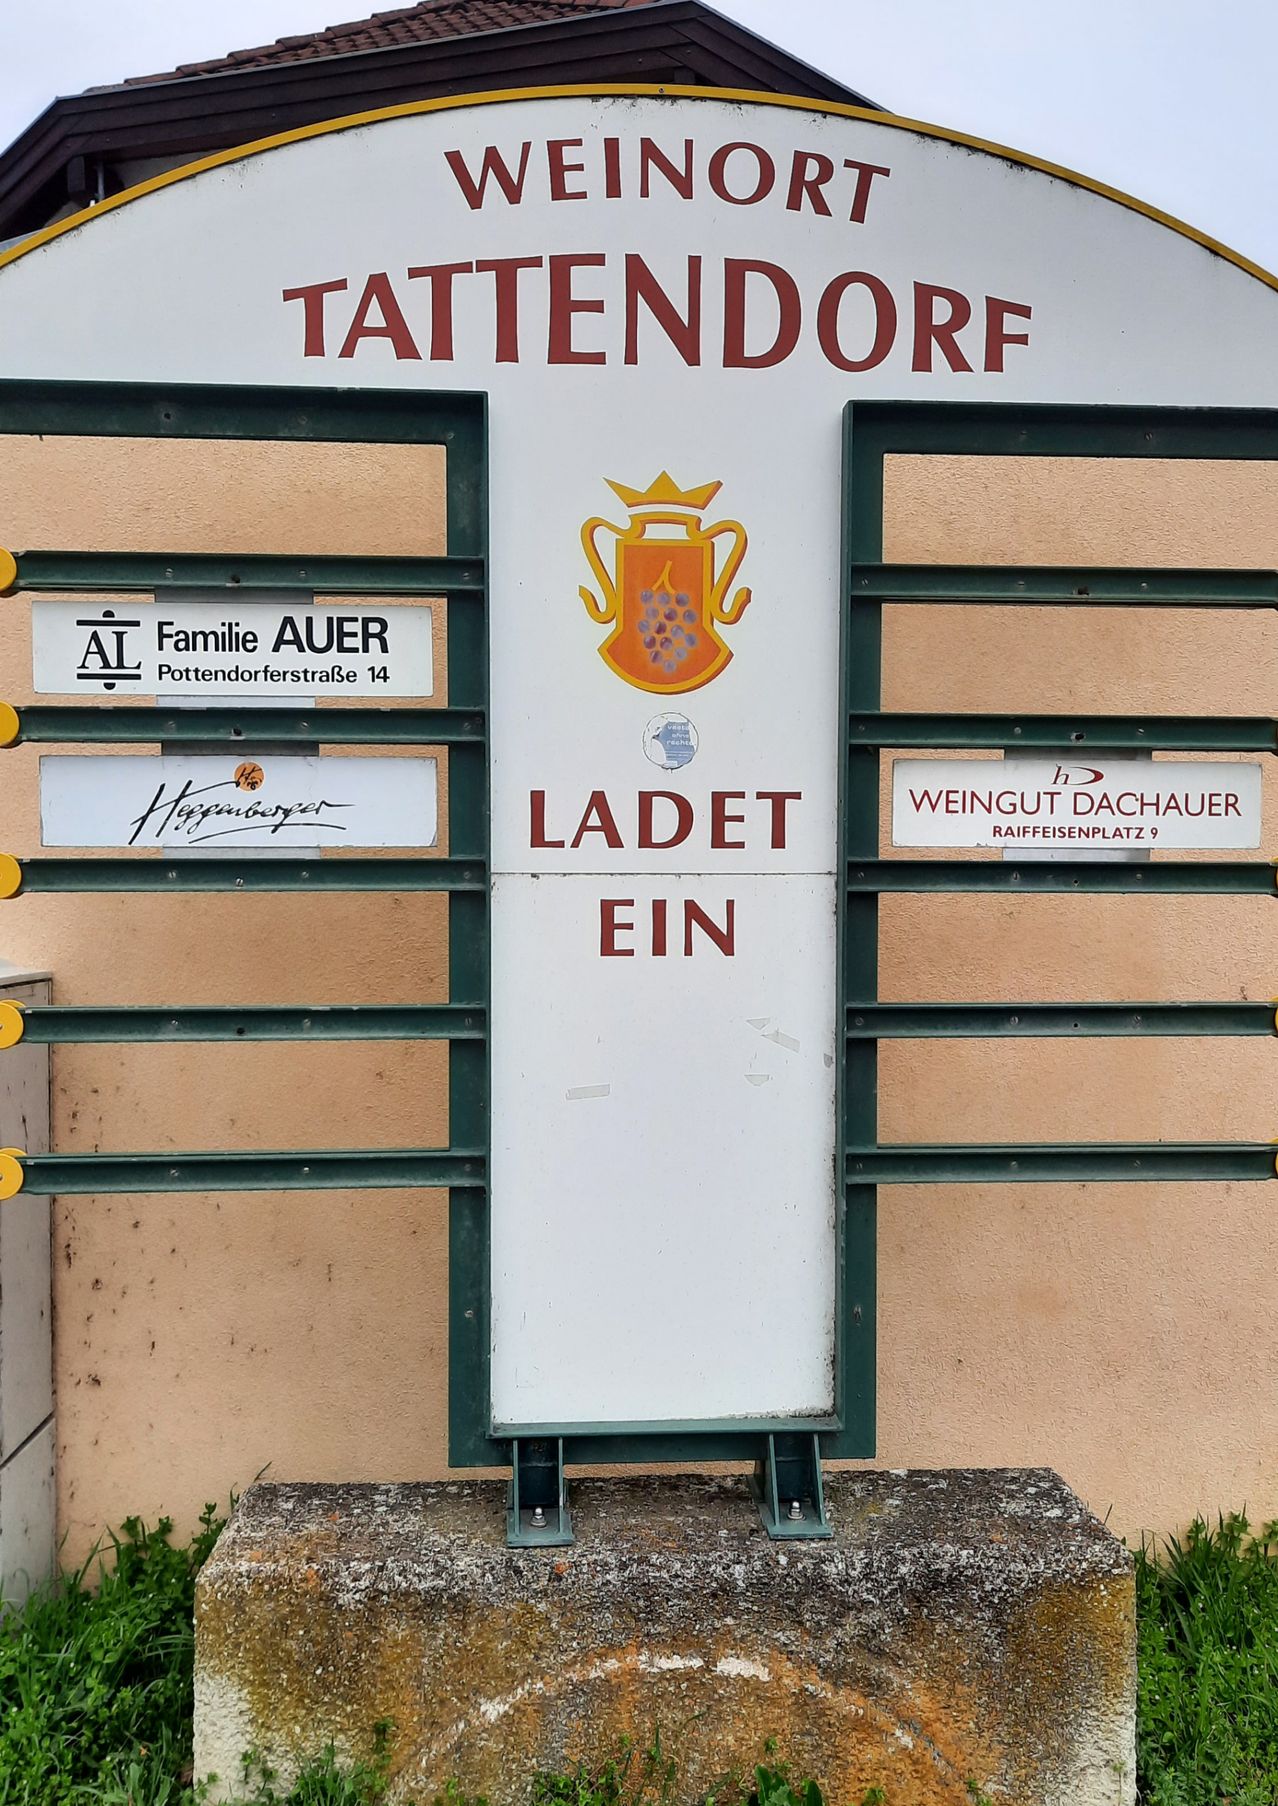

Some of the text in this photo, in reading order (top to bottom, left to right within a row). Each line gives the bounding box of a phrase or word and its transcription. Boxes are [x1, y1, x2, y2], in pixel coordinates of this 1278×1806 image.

[445, 137, 891, 224] WEINORT
[282, 252, 1033, 374] TATTENDORF
[157, 615, 390, 655] Familie AUER
[158, 663, 391, 684] Pottendorferstraße 14
[129, 779, 357, 846] Heggenberger
[529, 789, 803, 850] LADET
[908, 788, 1243, 817] WEINGUT DACHAUER
[992, 825, 1158, 840] RAIFFEISENPLATZ 9
[599, 898, 736, 958] EIN
